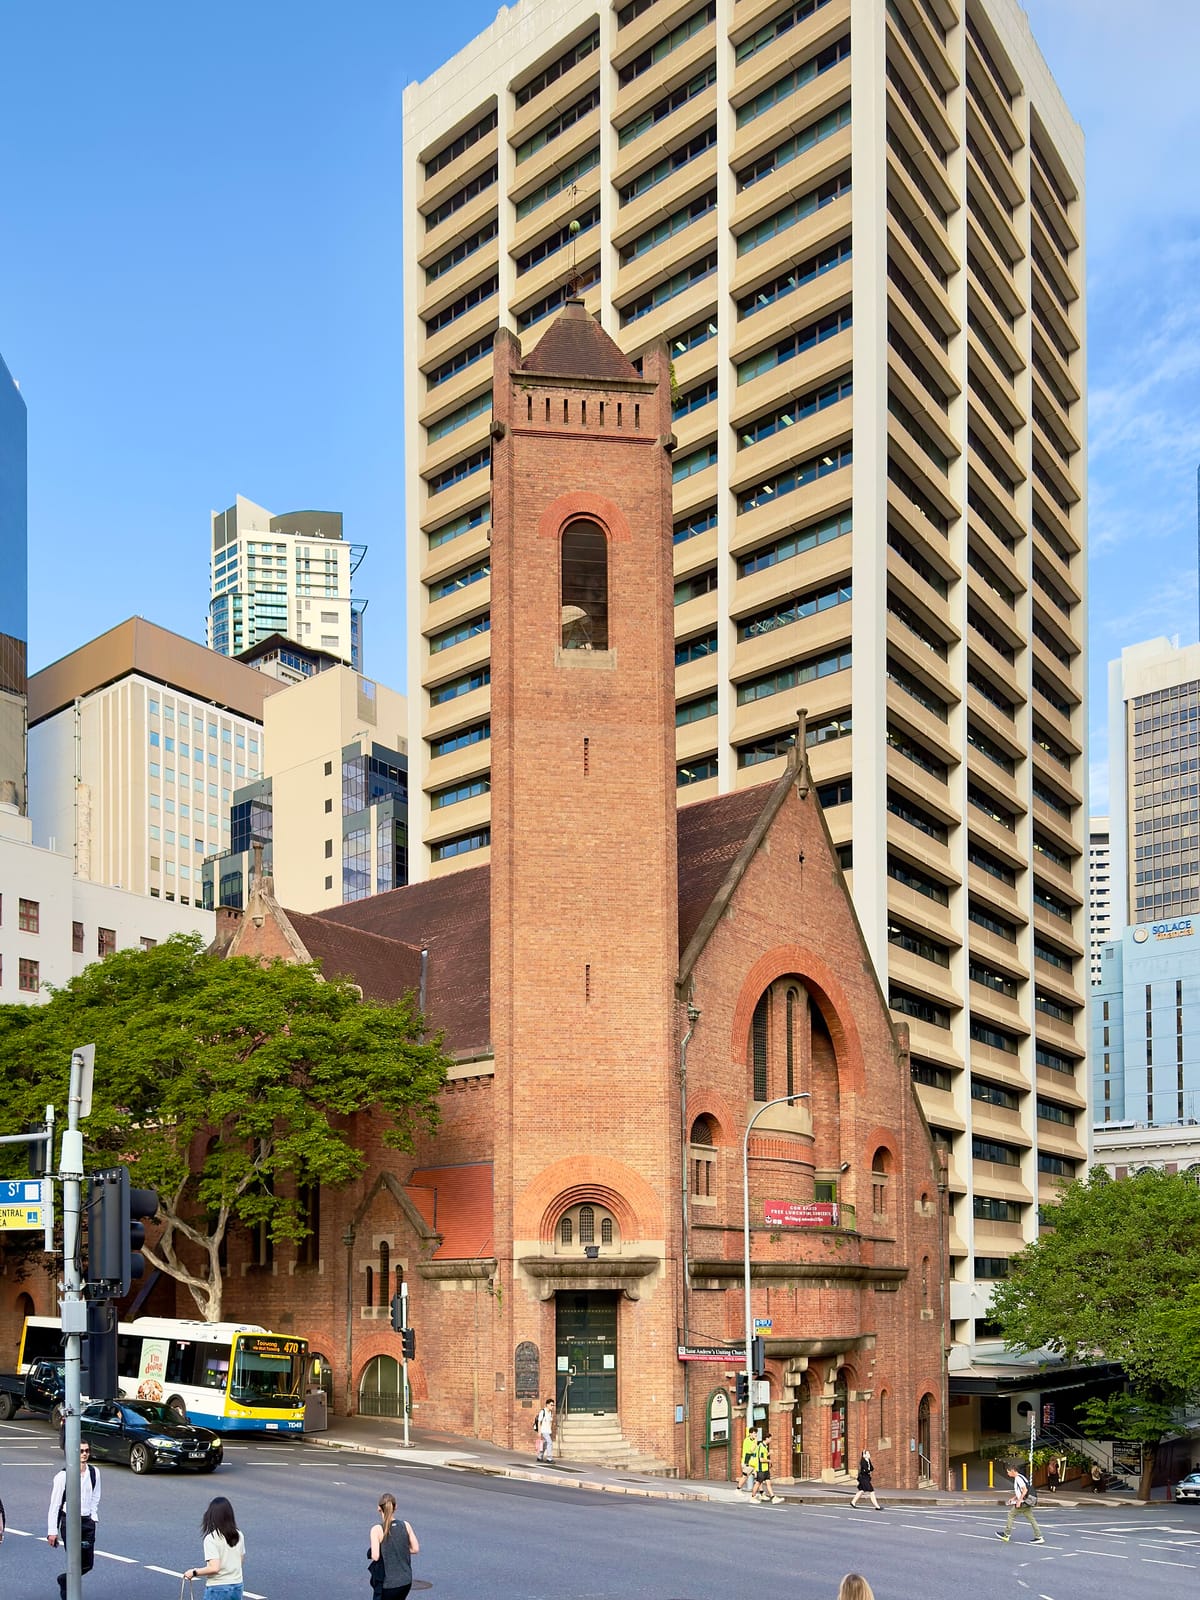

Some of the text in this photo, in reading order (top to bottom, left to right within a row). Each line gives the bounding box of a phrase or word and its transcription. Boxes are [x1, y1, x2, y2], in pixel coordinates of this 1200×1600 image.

[1152, 920, 1192, 935] SOLACE
[8, 1182, 21, 1197] ST
[283, 1341, 299, 1353] 470
